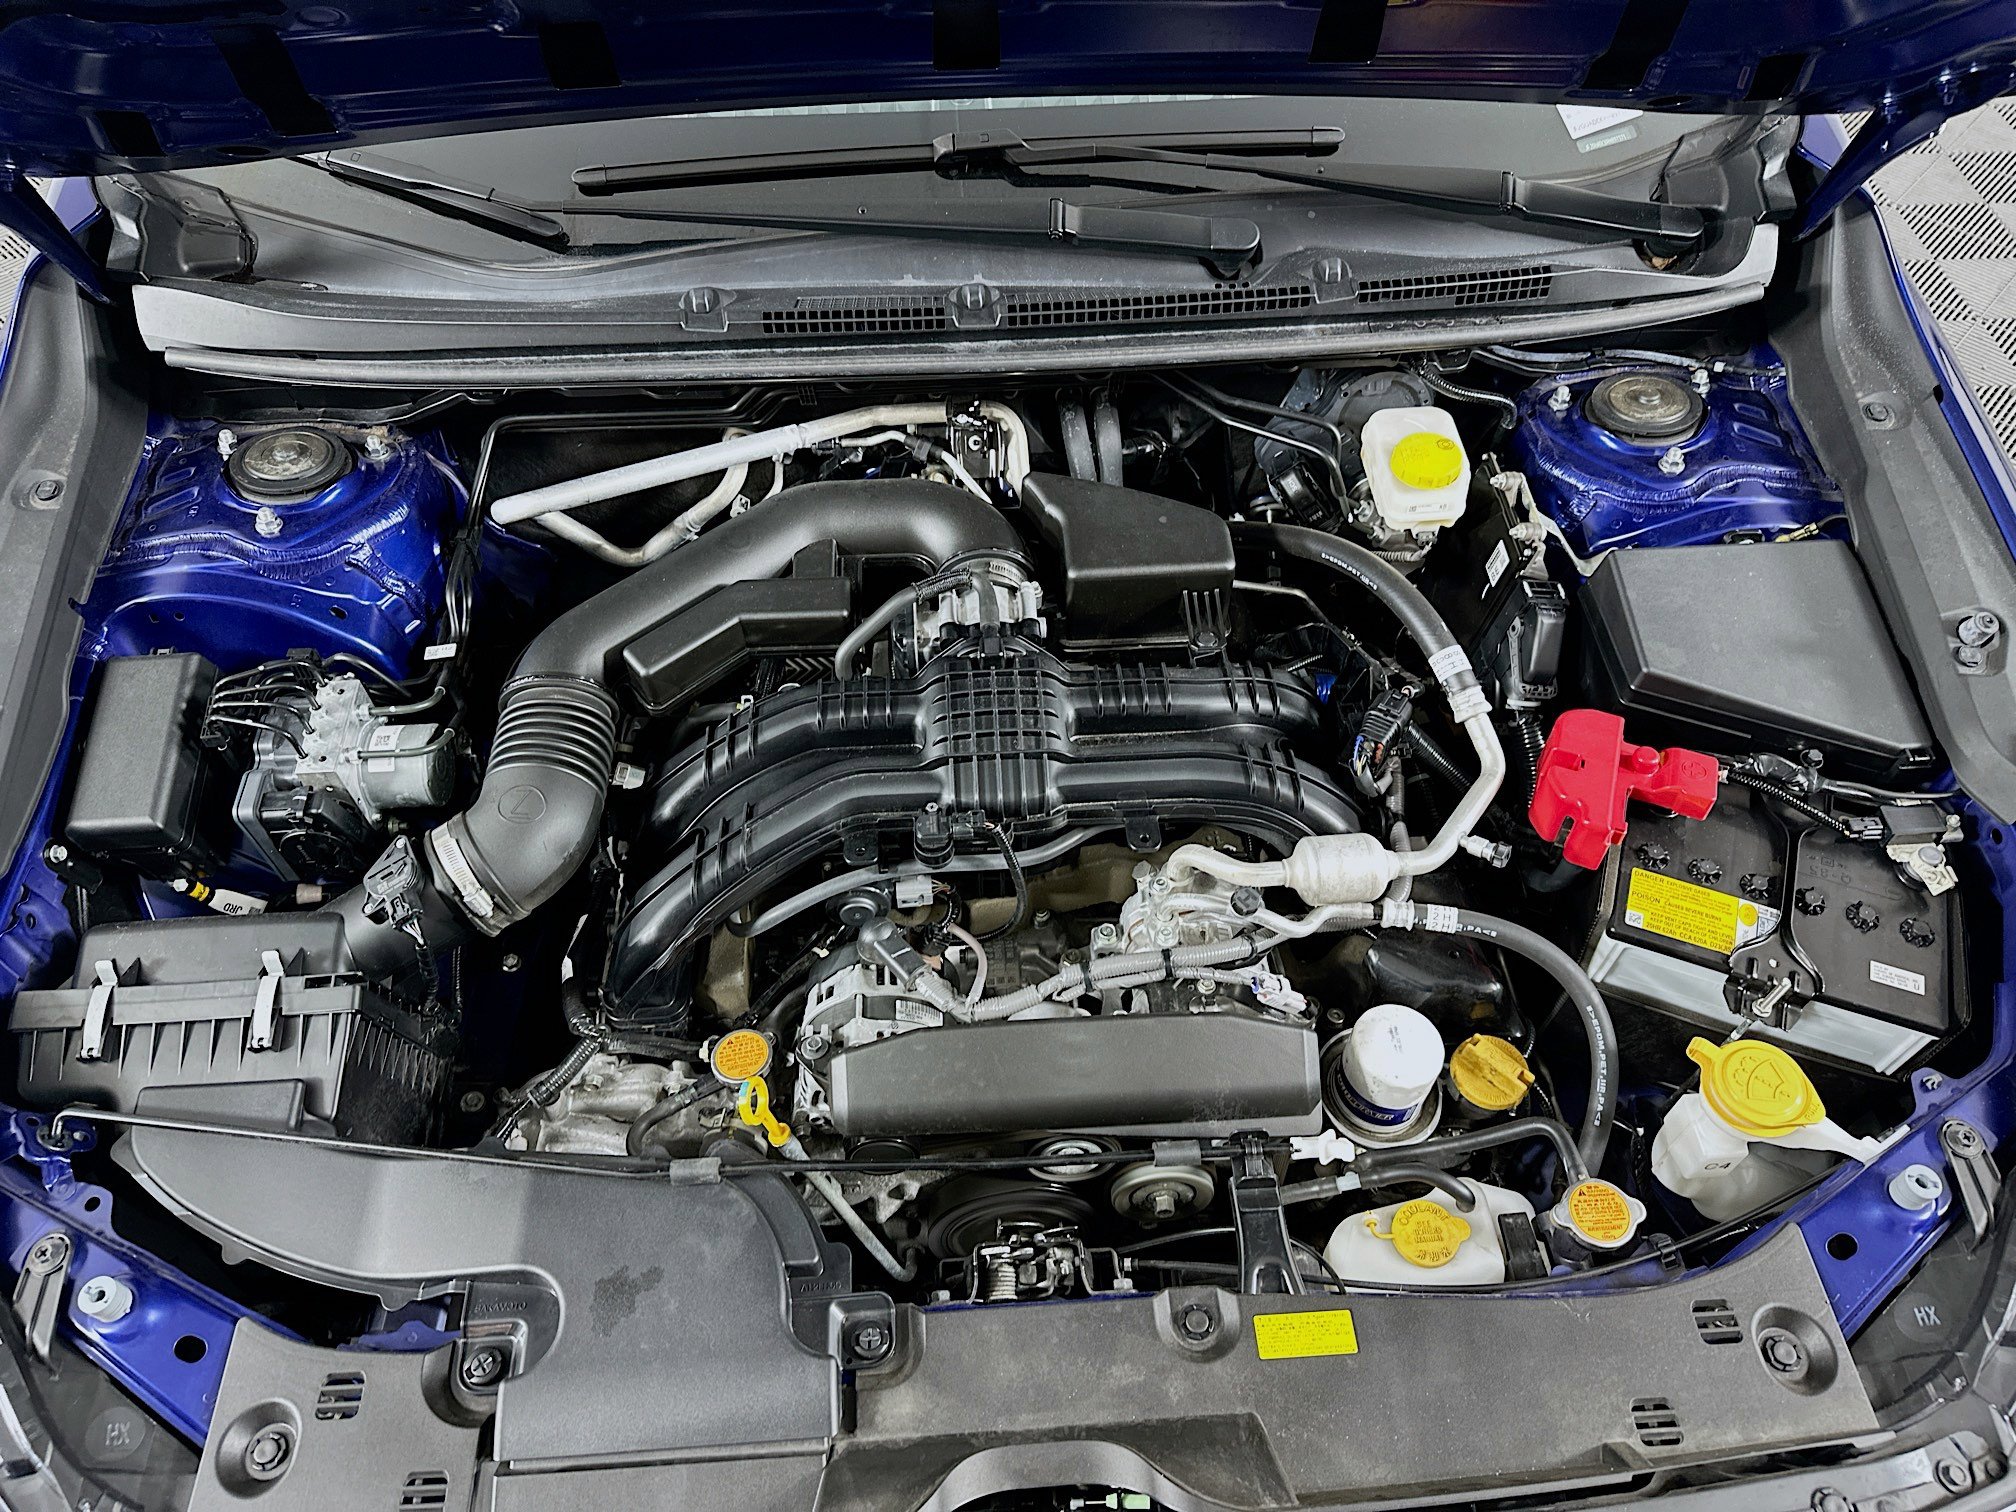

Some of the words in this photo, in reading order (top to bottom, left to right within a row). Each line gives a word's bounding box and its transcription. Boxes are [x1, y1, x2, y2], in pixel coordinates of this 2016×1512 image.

[1634, 870, 1663, 883] DANGER
[1666, 880, 1692, 891] EXPLOSIVE
[222, 902, 243, 915] JRD
[1631, 890, 1660, 904] POISON
[1664, 901, 1683, 910] CAUSES
[1685, 907, 1703, 916] SEVERE
[1705, 913, 1721, 921] BURNS
[1679, 932, 1691, 940] CCA
[1683, 926, 1699, 934] REACH
[1707, 934, 1732, 945] CHILDREN
[1704, 1162, 1731, 1171] C4
[1399, 1204, 1451, 1226] COOLANT
[1913, 1305, 1942, 1327] HX
[105, 1421, 131, 1446] HX
